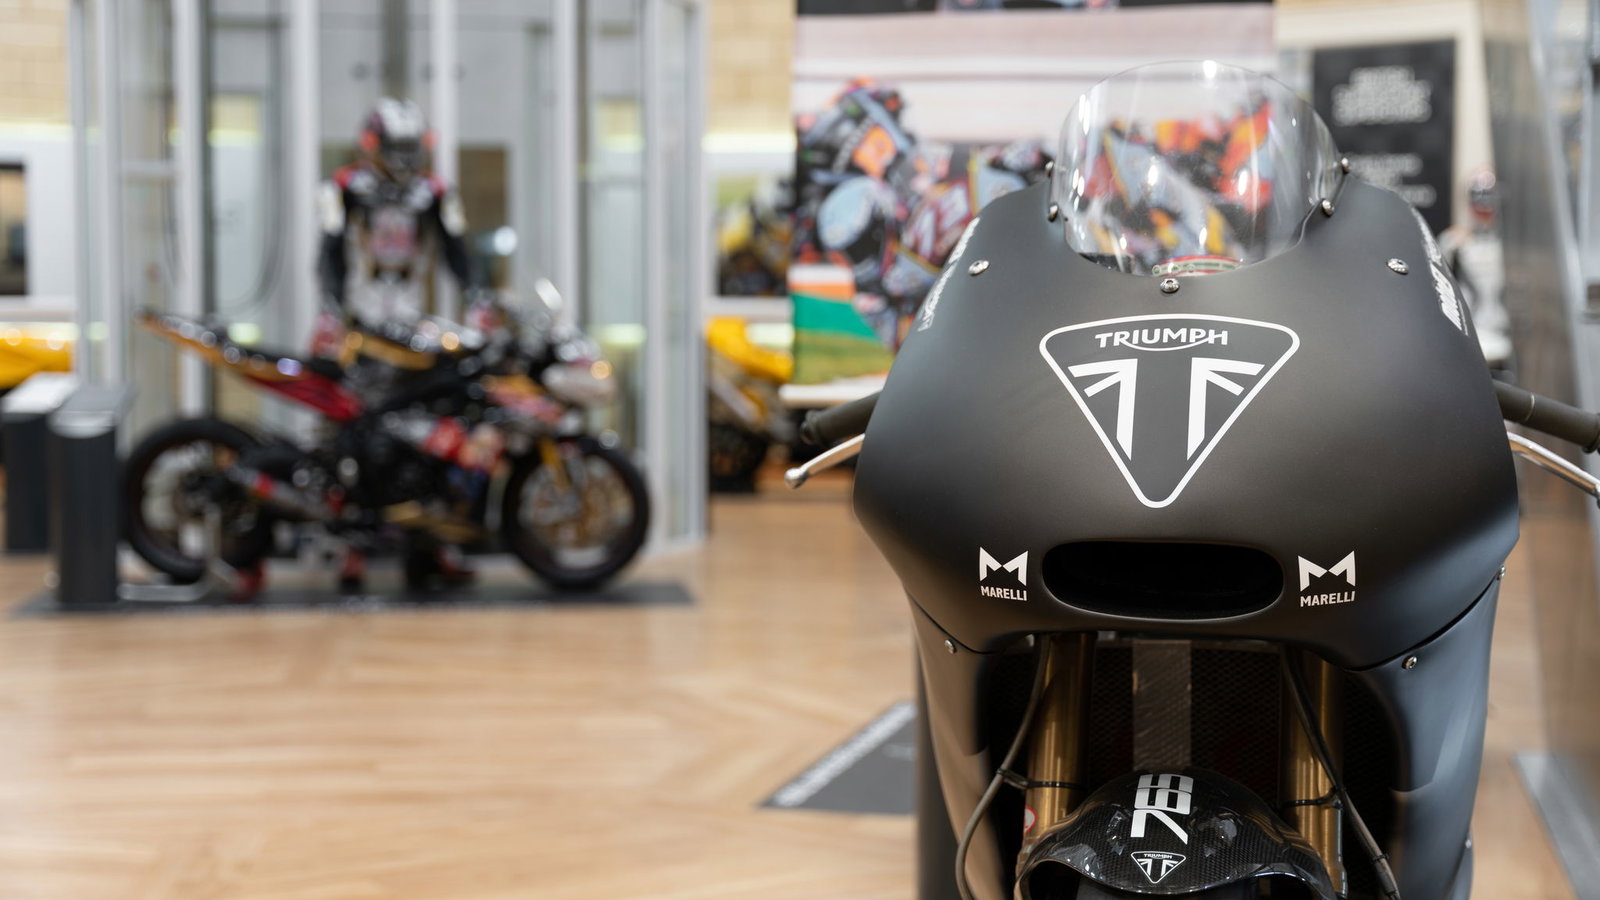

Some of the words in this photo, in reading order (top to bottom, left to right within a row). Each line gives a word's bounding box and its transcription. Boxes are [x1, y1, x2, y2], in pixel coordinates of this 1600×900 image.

[1095, 328, 1228, 351] TRIUMPH
[980, 585, 1028, 601] MARELLI
[1300, 590, 1356, 608] MARELLI
[1130, 773, 1194, 845] 765
